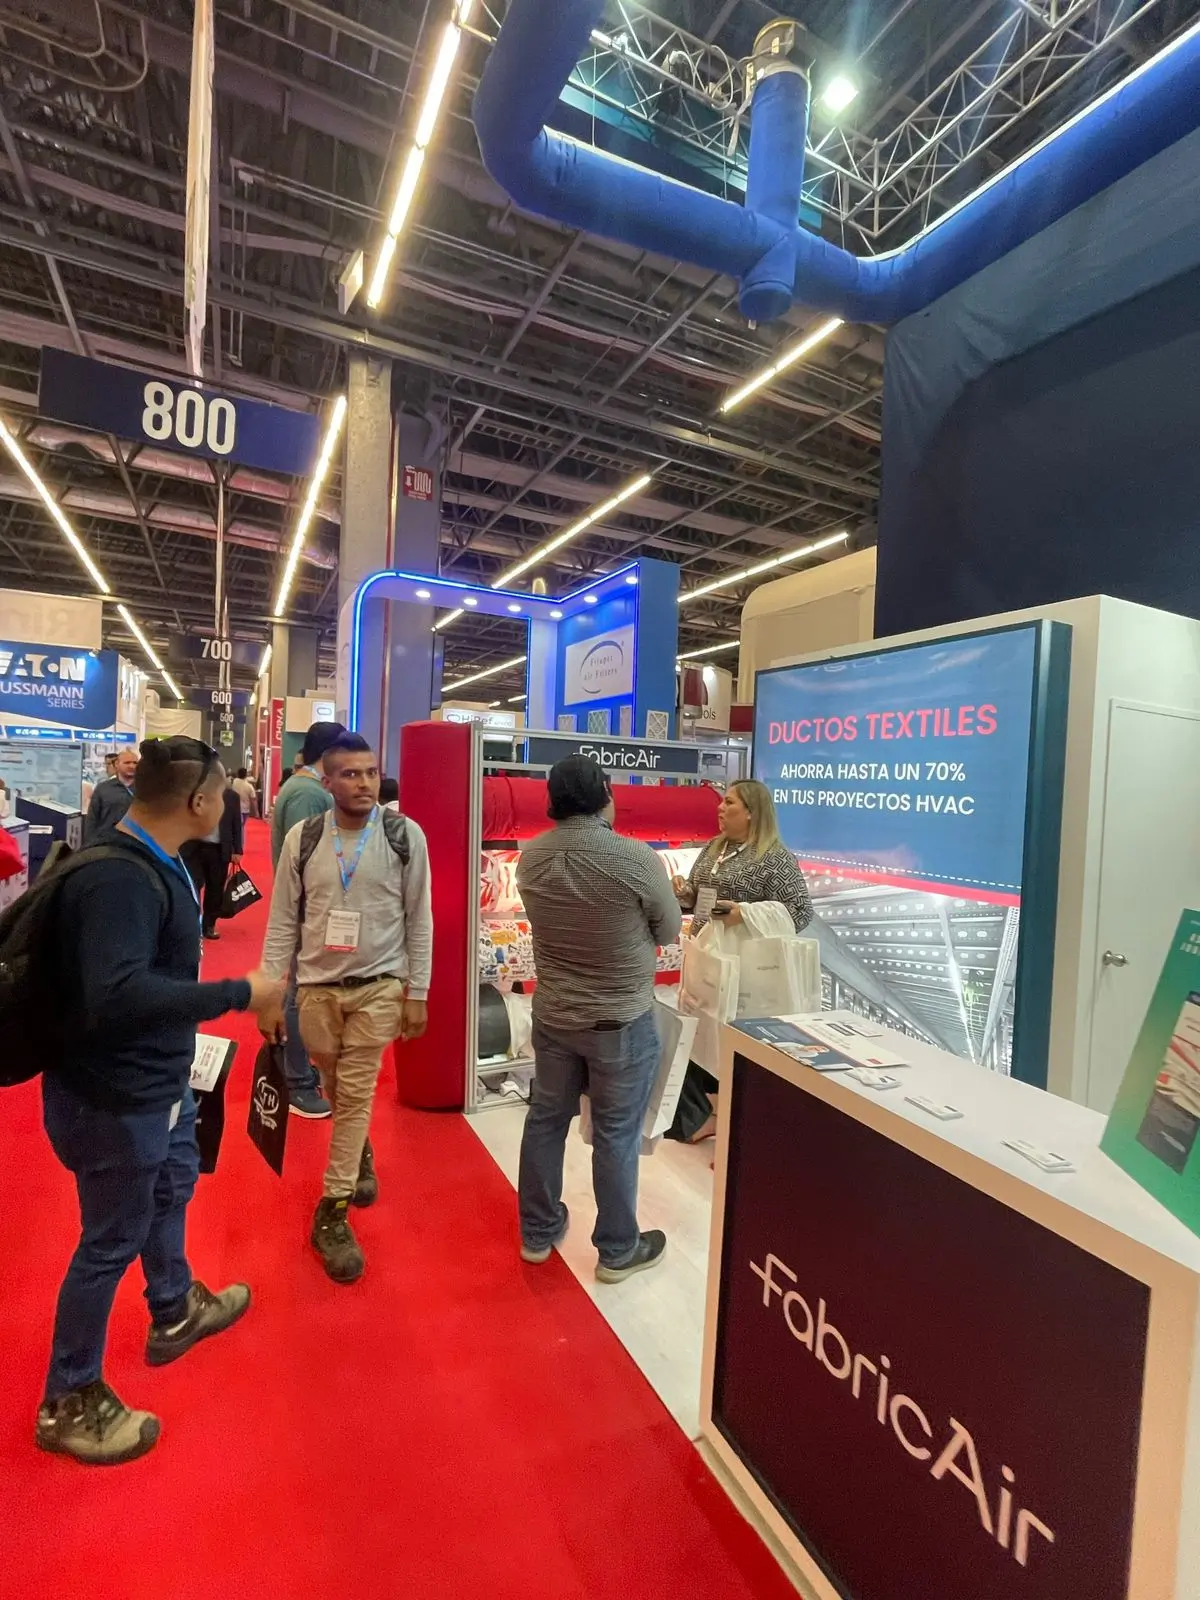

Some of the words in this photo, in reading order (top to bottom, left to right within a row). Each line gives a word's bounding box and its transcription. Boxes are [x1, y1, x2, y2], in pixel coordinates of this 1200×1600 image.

[142, 381, 237, 455] 800
[200, 638, 232, 660] 700
[47, 697, 85, 709] SERIES
[211, 690, 232, 705] 600
[220, 712, 234, 723] 500
[275, 707, 284, 740] CHINA
[768, 714, 858, 745] DUCTOS
[866, 704, 998, 740] TEXTILES
[573, 745, 661, 769] FabricAir
[780, 763, 834, 779] AHORRA
[837, 763, 889, 780] HASTA
[894, 763, 920, 780] UN
[925, 762, 966, 782] 70%
[773, 788, 789, 804] EN
[791, 789, 815, 805] TUS
[818, 791, 911, 811] PROYECTOS
[916, 794, 975, 815] HVAC
[750, 1253, 1055, 1568] FabricAir
